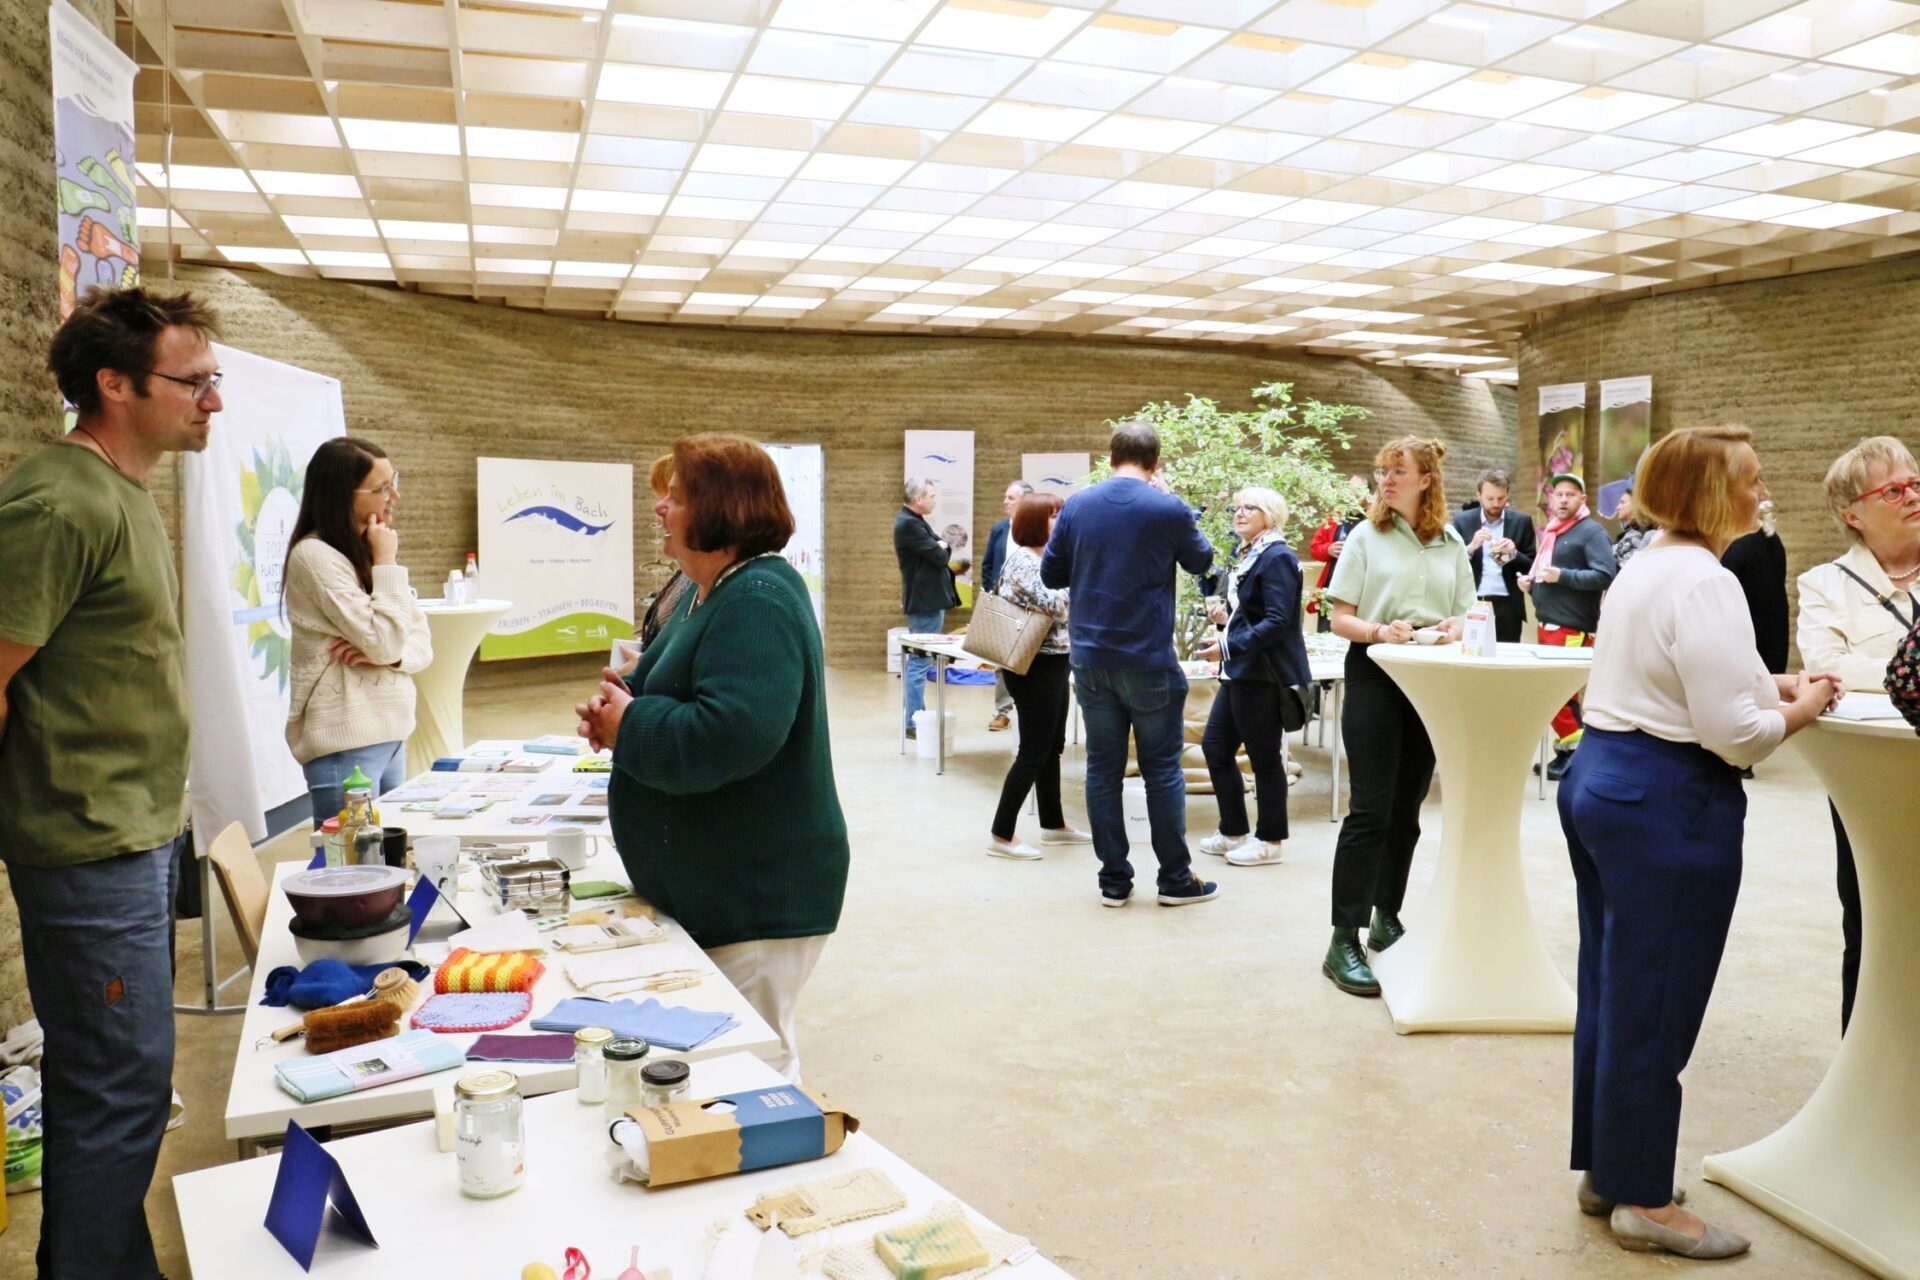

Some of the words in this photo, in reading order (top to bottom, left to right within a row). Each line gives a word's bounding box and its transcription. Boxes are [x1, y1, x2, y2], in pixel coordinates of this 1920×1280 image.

[496, 485, 543, 512] Leben
[551, 484, 566, 503] im
[575, 496, 608, 518] Bach
[498, 616, 530, 629] ERLEBEN
[538, 600, 572, 619] STAUNEN
[581, 598, 619, 612] BEGREIFEN
